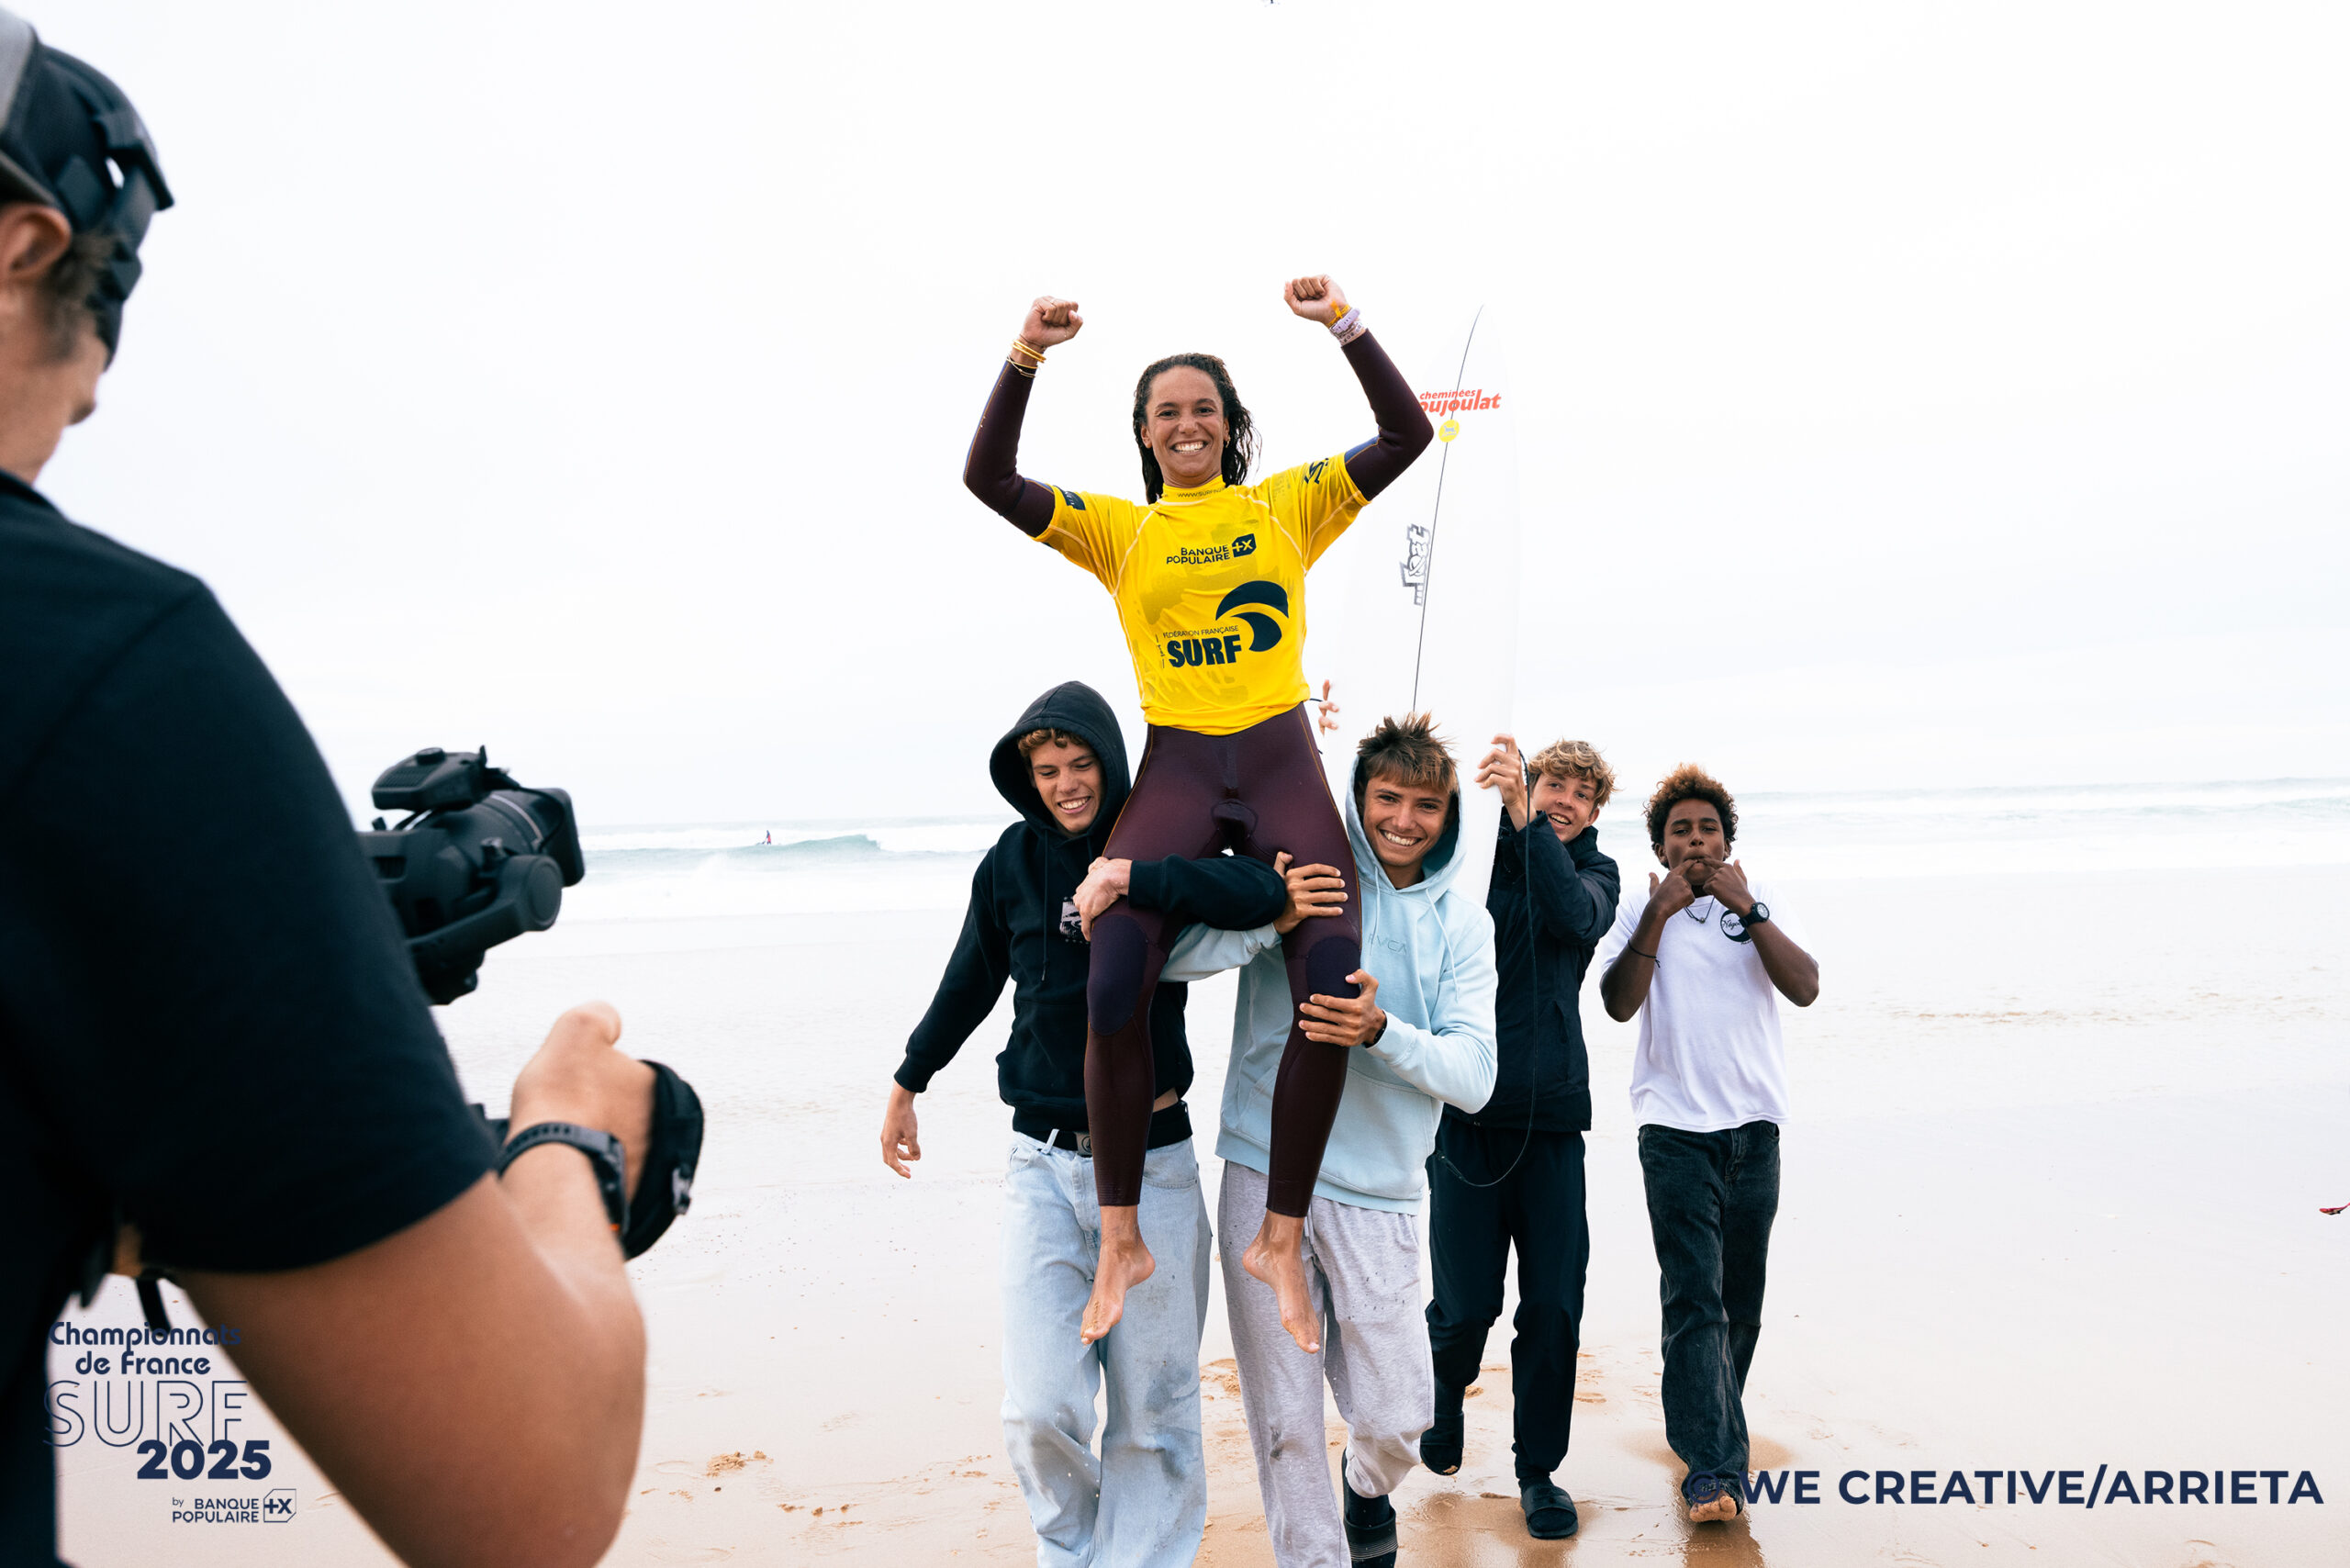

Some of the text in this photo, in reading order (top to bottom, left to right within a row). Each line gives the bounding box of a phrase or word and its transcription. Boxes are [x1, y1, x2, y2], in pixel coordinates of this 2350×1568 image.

[1419, 389, 1476, 400] cheminées
[1420, 389, 1502, 417] oujoulat
[1181, 544, 1229, 556] BANQUE
[1166, 552, 1231, 565] POPULAIRE
[1167, 634, 1242, 668] SURF
